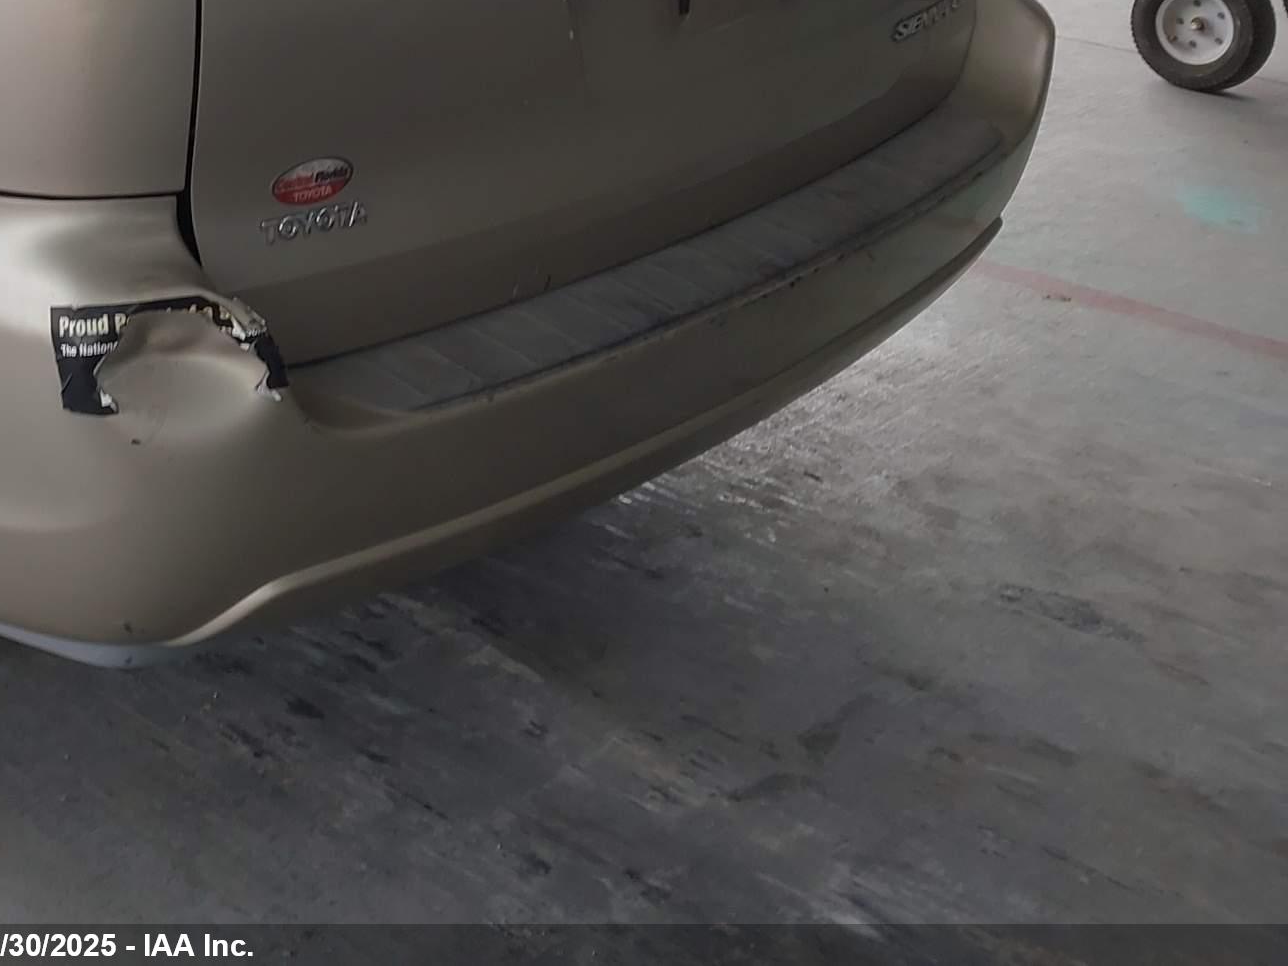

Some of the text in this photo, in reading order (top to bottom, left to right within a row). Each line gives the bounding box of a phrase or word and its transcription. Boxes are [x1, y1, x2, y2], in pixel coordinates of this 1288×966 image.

[294, 185, 332, 203] TOYOTA
[259, 201, 368, 246] TOYOTA
[59, 313, 110, 338] Proud
[60, 343, 77, 358] The
